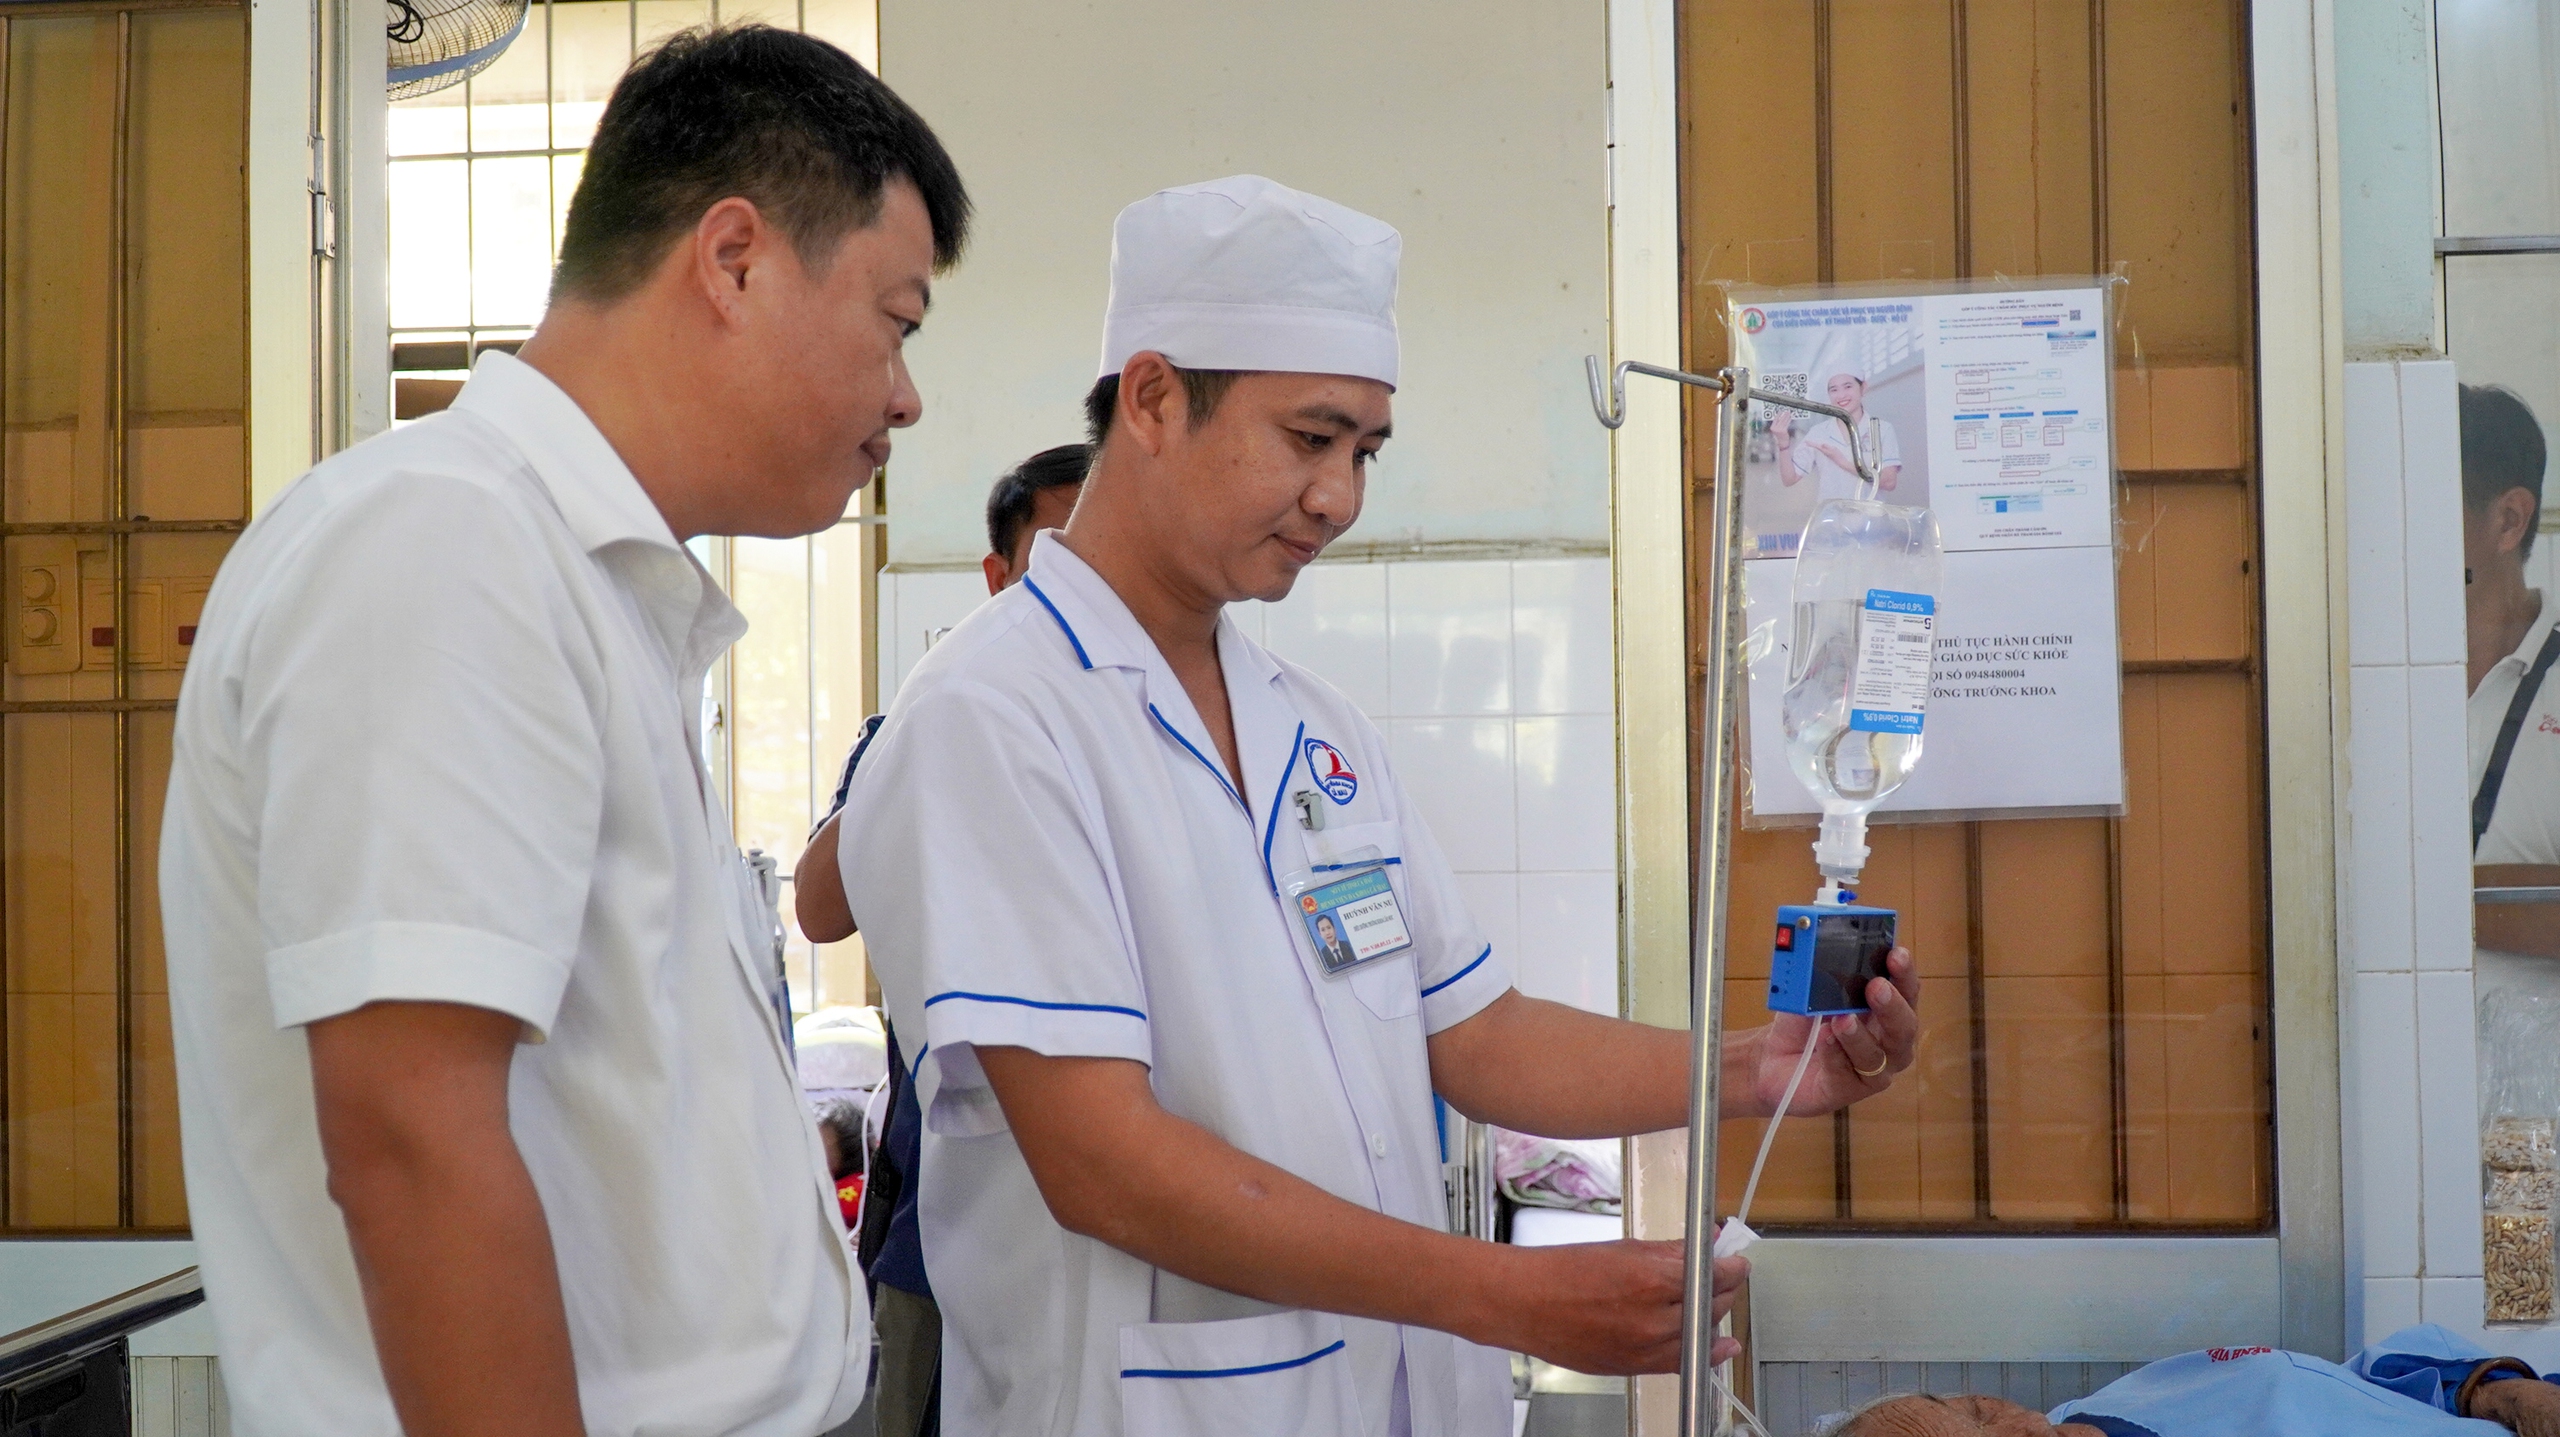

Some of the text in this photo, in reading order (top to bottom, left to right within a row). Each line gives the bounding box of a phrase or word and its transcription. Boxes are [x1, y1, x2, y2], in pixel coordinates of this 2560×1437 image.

[1937, 633, 2072, 649] THỦ TỤC HÀNH CHÍNH
[1941, 650, 1972, 662] GIÁO
[1976, 651, 2002, 664] DỤC
[2005, 650, 2029, 661] SỨC
[2033, 648, 2069, 660] KHỎE
[1946, 668, 1962, 681] SỐ
[1965, 669, 2025, 680] 0948480004
[1964, 686, 2017, 698] TRƯỞNG
[2021, 686, 2056, 696] KHOA
[1900, 715, 1919, 724] Natri
[1369, 901, 1383, 912] VĂN
